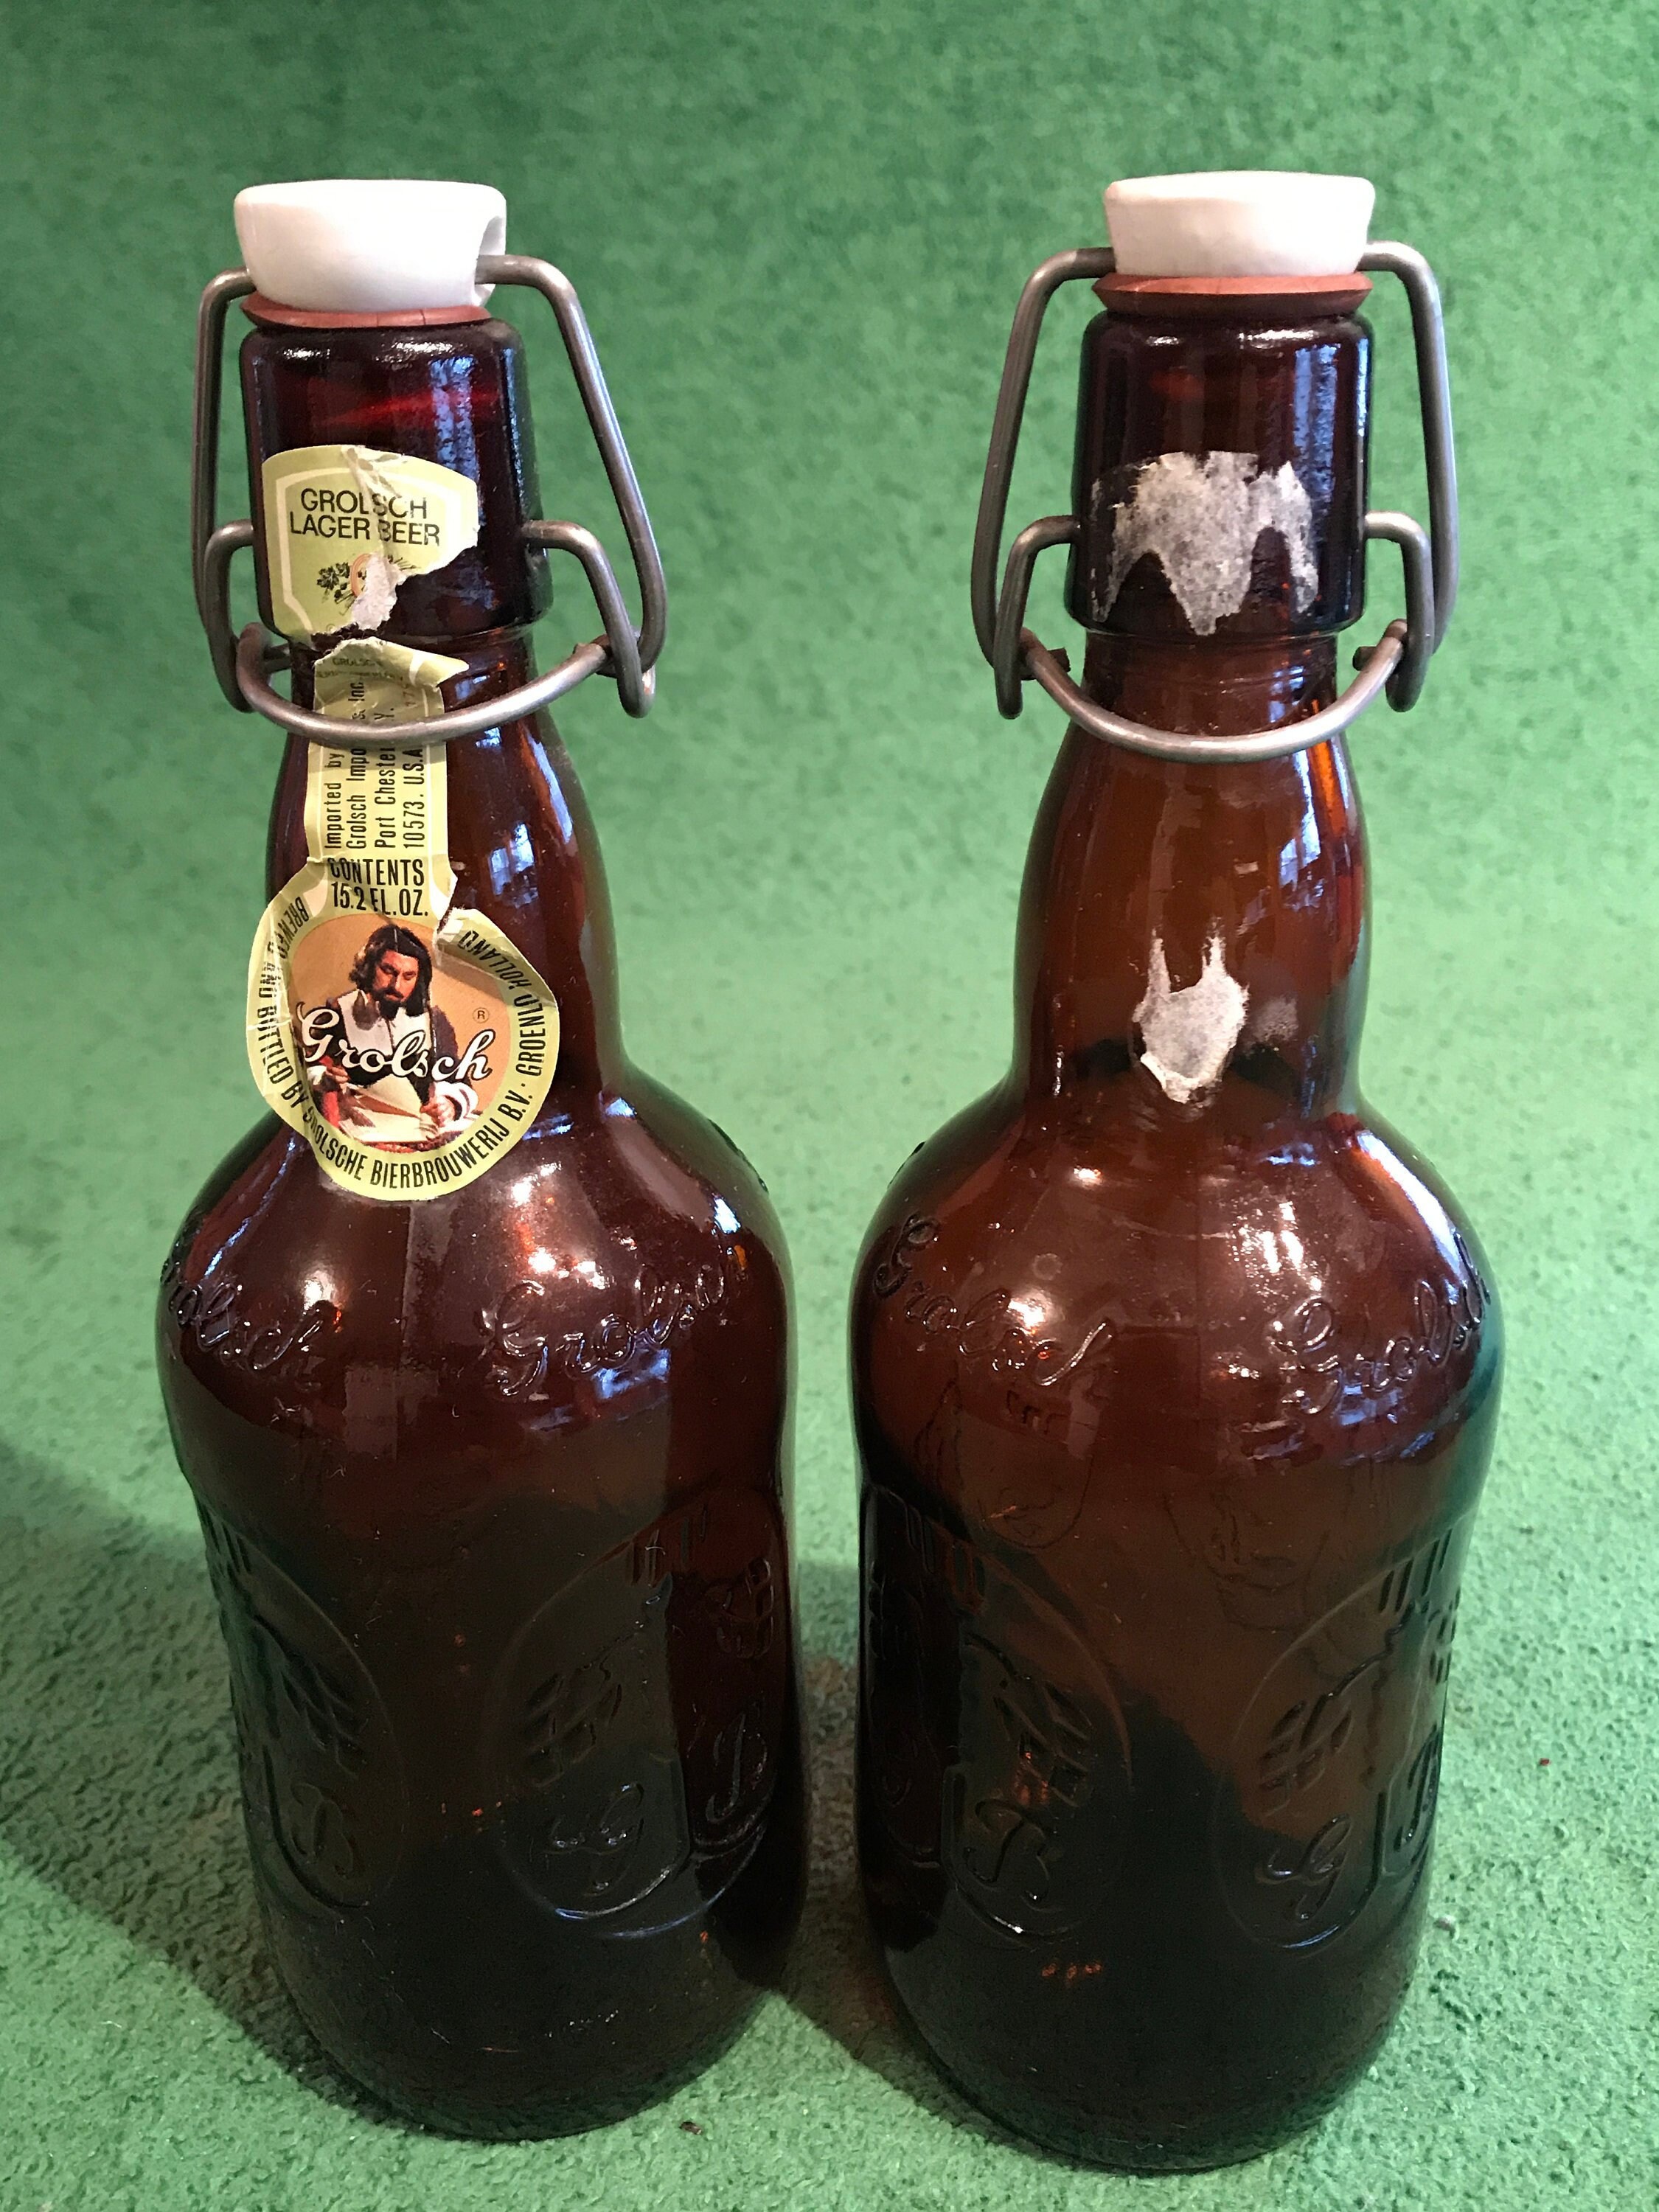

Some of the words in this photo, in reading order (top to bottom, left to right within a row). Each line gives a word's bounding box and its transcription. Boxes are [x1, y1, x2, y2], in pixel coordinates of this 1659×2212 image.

[300, 487, 428, 520] GROLSCH
[290, 511, 370, 540] LAGER
[377, 518, 441, 547] BEER
[324, 753, 345, 768] by
[324, 782, 345, 849] Imported
[345, 794, 367, 849] Grolsch
[374, 816, 397, 849] Port
[327, 858, 425, 886] CONTENTS
[330, 882, 366, 911] 15.2
[458, 929, 533, 990] HOLLAND
[257, 1005, 294, 1085] BOTTLED
[296, 1001, 496, 1082] Grolsch
[280, 1079, 309, 1108] BY
[505, 1093, 533, 1122] B.V.
[370, 1117, 510, 1189] BIERBROUWERIJ
